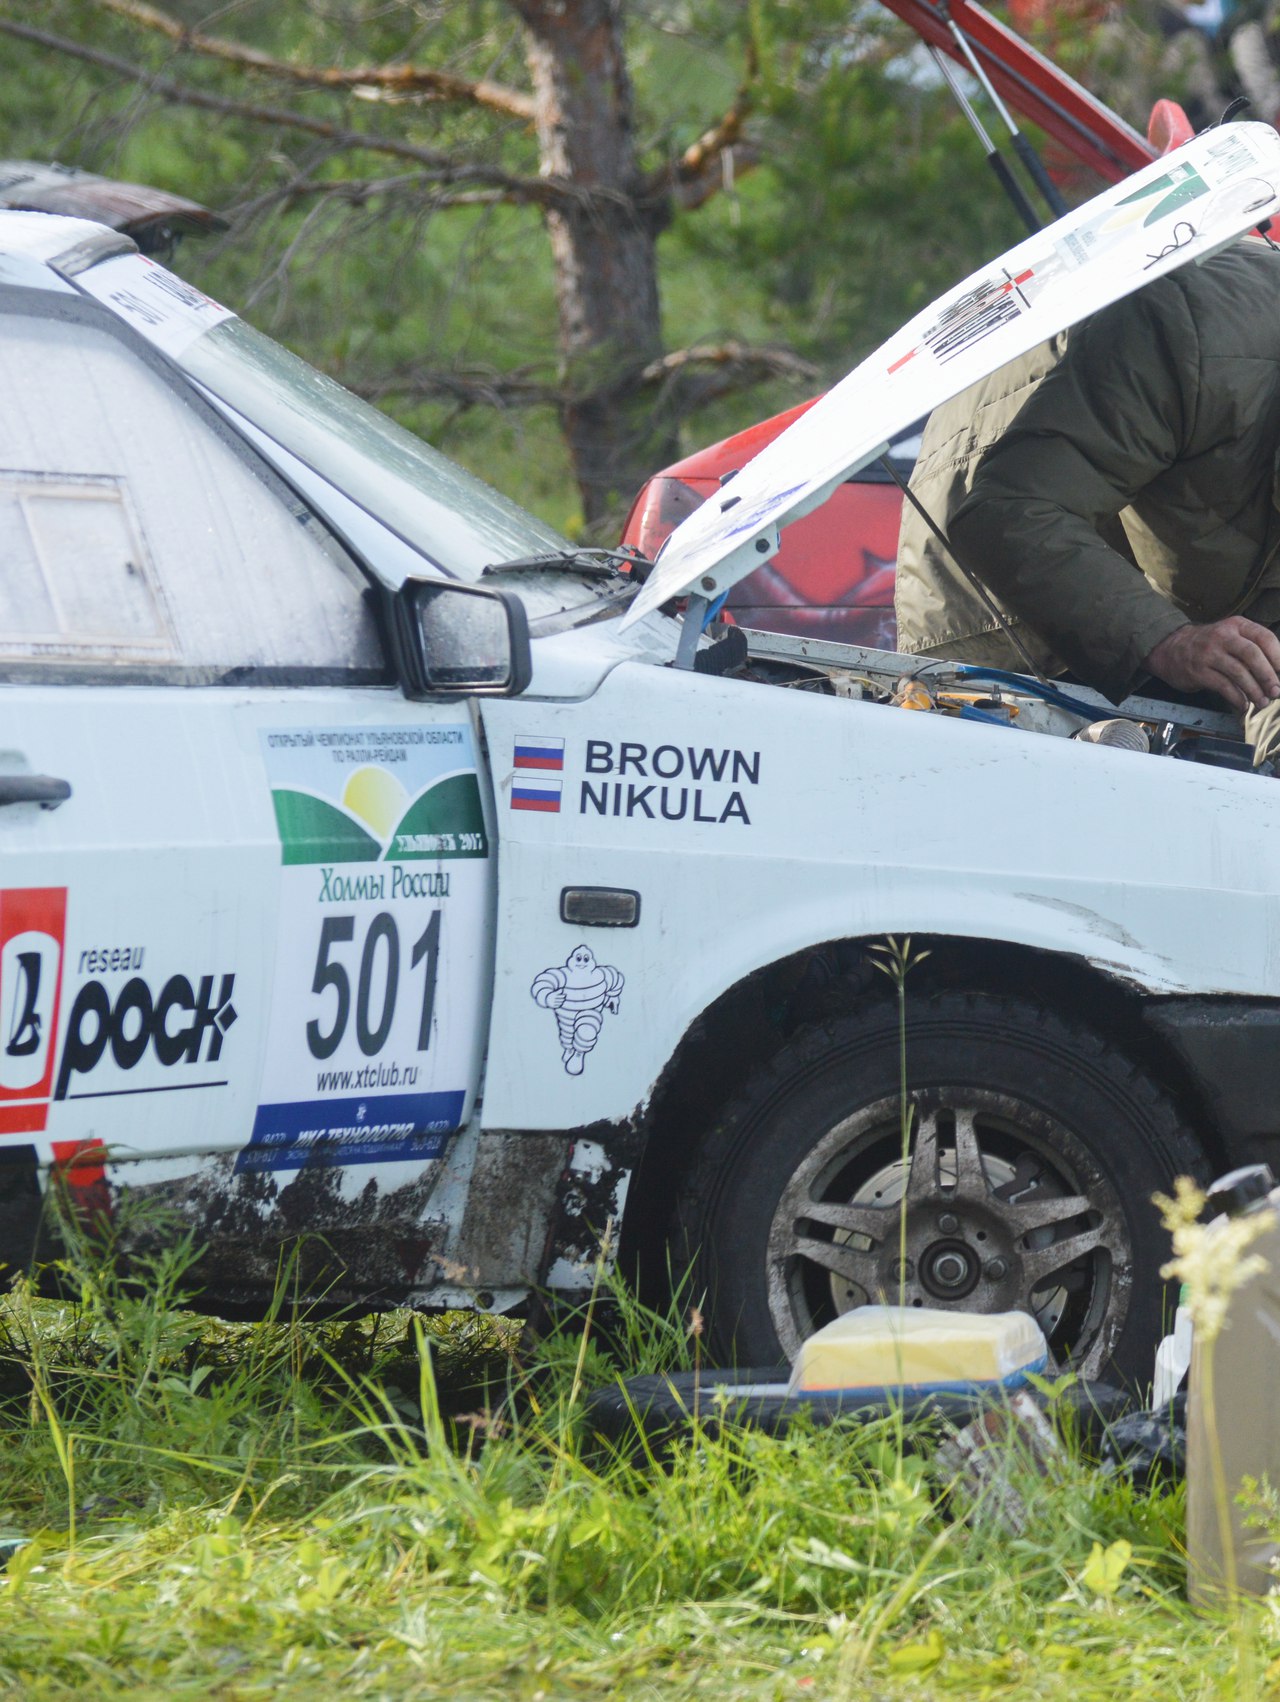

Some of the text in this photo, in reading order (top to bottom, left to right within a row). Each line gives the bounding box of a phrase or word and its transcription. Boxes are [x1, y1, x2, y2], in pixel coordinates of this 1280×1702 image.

[268, 731, 315, 748] ОТКРЫТЫЙ
[317, 731, 365, 748] ЧЕМПИОНАТ
[426, 730, 464, 745] ОБЛАСТИ
[332, 748, 345, 764] ПО
[585, 739, 761, 785] BROWN
[580, 780, 752, 826] NIKULA
[318, 865, 451, 902] Холмы России
[306, 909, 442, 1061] 501
[316, 1062, 419, 1091] www.xtclub.ru
